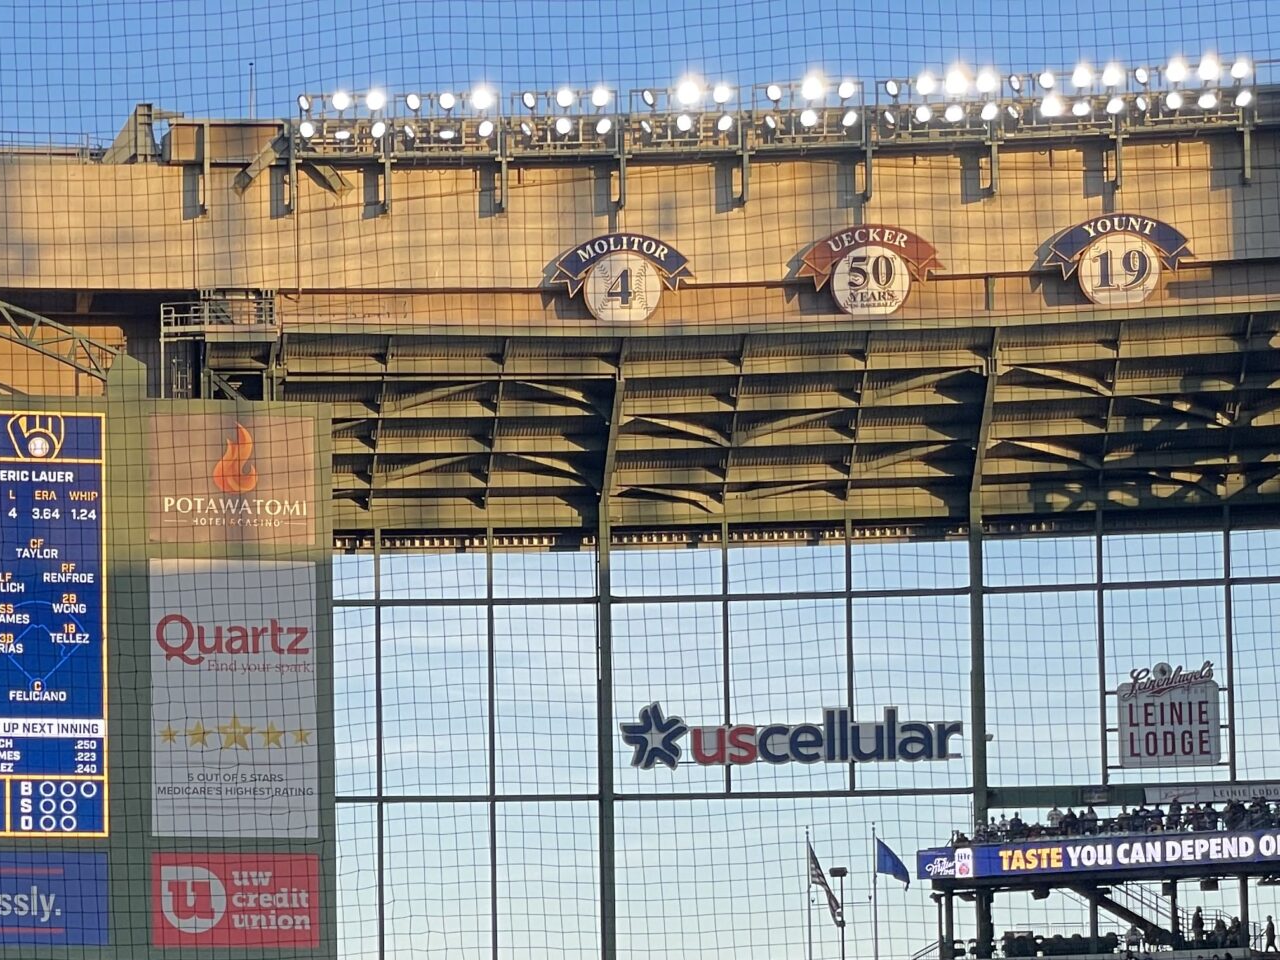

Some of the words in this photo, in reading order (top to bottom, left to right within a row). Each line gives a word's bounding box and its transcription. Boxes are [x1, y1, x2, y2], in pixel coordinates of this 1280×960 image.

[1082, 217, 1156, 239] YOUNT
[827, 228, 908, 252] UECKER
[577, 236, 670, 263] MOLITOR
[847, 255, 896, 289] 50
[1091, 249, 1152, 291] 19
[606, 267, 634, 309] 4
[850, 290, 897, 301] YEARS
[0, 470, 29, 481] ERIC
[31, 471, 74, 482] LAUER
[164, 497, 306, 515] POTAWATOMI
[16, 549, 58, 558] TAYLOR
[43, 573, 94, 583] RENFROE
[52, 604, 87, 613] WONG
[50, 633, 90, 644] TELLEZ
[155, 614, 310, 666] Quartz
[207, 659, 237, 673] Find
[240, 662, 271, 676] your
[9, 691, 67, 701] FELICIANO
[1128, 700, 1210, 727] LEINIE
[3, 722, 19, 733] UP
[22, 723, 54, 734] NEXT
[57, 723, 99, 735] INNING
[691, 707, 963, 766] uscellular
[1129, 729, 1211, 757] LODGE
[196, 773, 221, 782] OUT
[223, 773, 239, 782] OF
[250, 774, 284, 782] STARS
[157, 786, 222, 795] MEDICARE'S
[225, 787, 271, 796] HIGHEST
[275, 787, 314, 796] RATING
[1213, 788, 1247, 797] LEINIE
[999, 847, 1064, 871] TASTE
[1066, 844, 1113, 867] YOU
[1116, 841, 1162, 864] CAN
[1165, 836, 1255, 861] DEPEND
[1259, 833, 1280, 856] O
[232, 871, 273, 887] uw
[232, 888, 309, 908] credit
[232, 909, 311, 930] union
